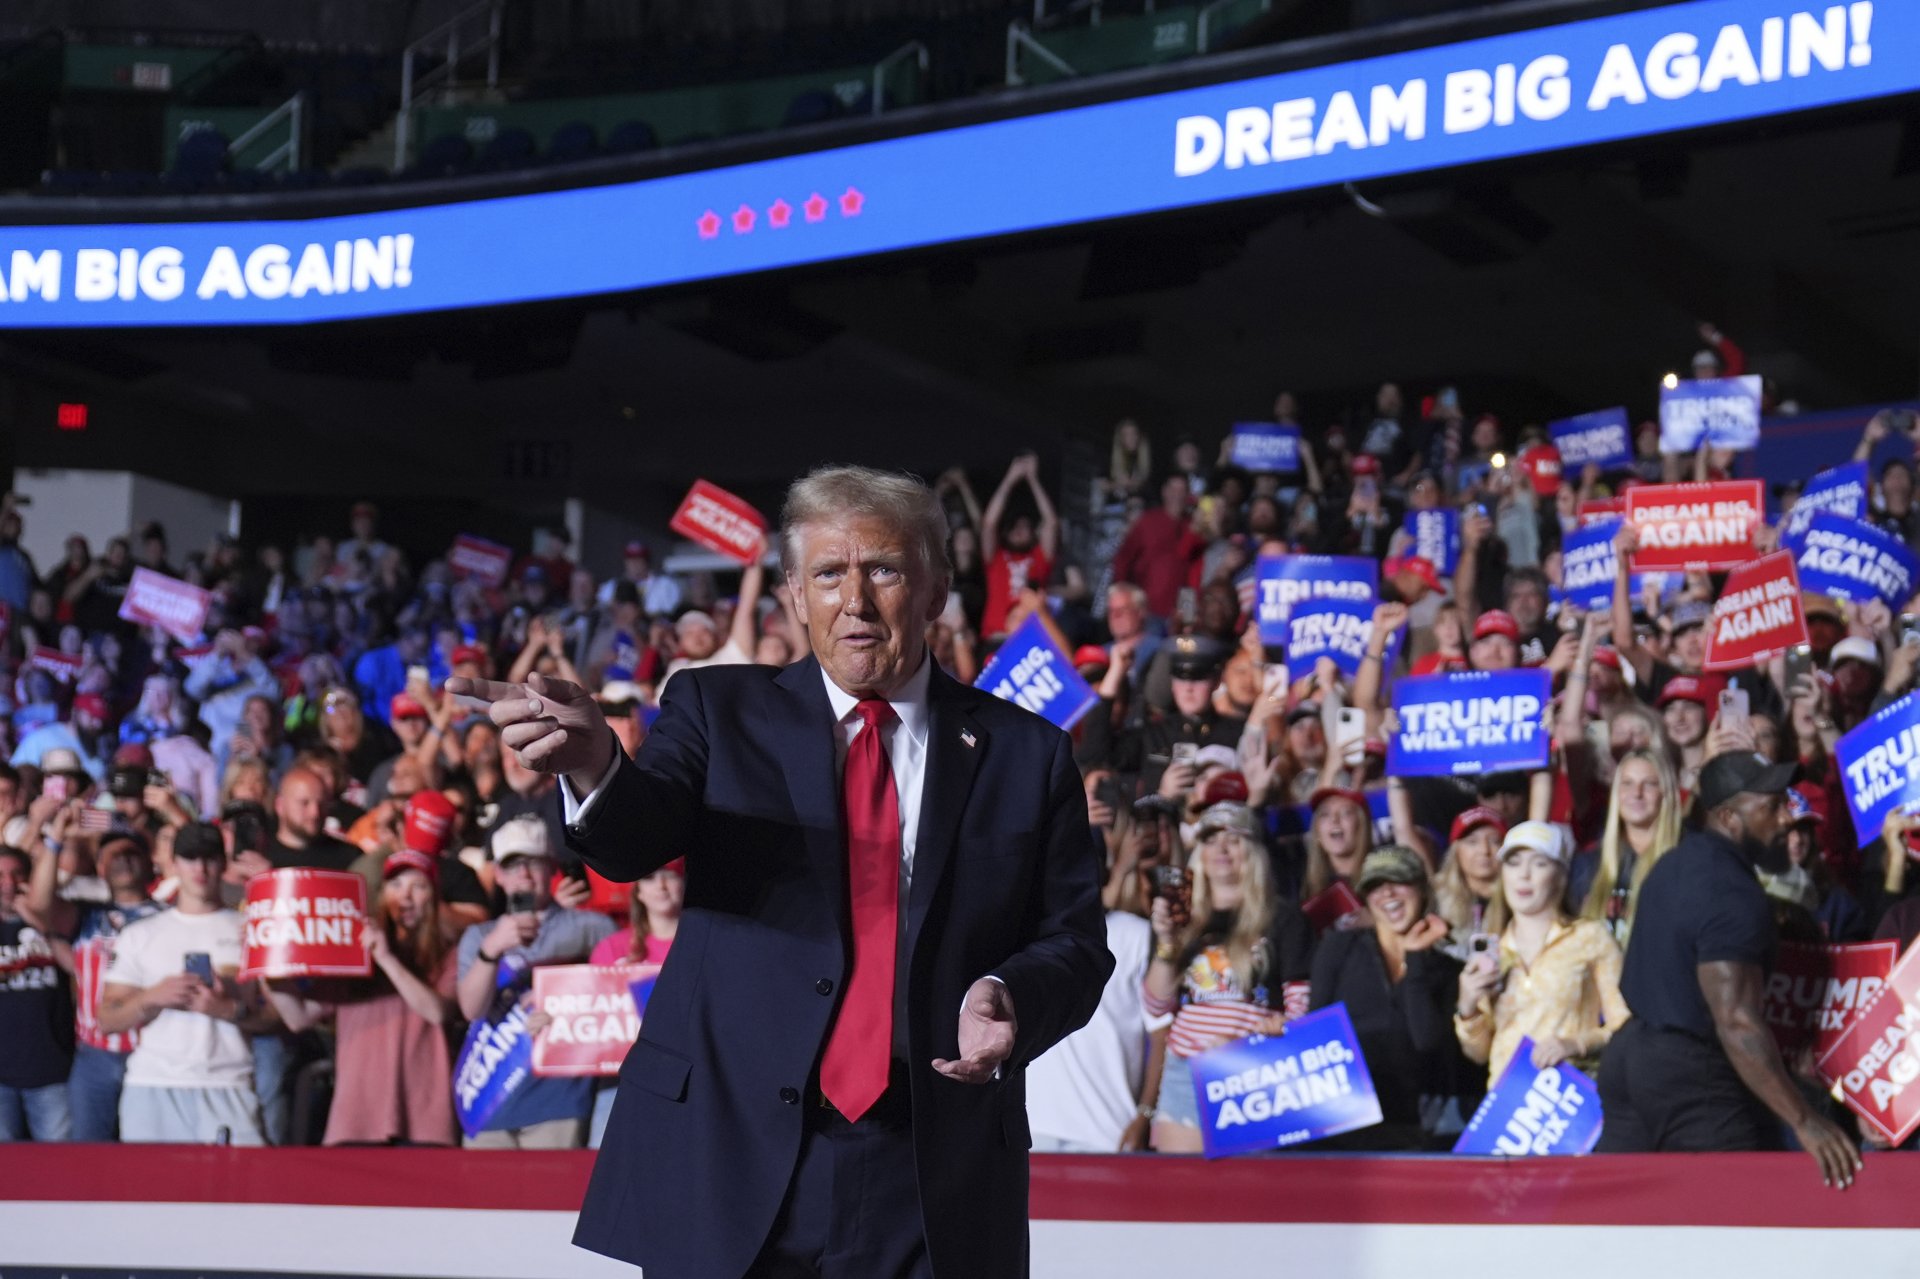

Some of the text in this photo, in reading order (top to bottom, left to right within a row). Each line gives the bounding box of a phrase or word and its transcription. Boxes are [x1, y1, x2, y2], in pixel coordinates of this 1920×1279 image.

[1174, 1, 1873, 177] DREAM BIG AGAIN!
[0, 233, 414, 301] M BIG AGAIN!
[1634, 502, 1710, 521] DREAM
[1713, 499, 1757, 520] BIG,
[1639, 518, 1748, 547] AGAIN!
[1805, 530, 1878, 561] DREAM
[1797, 545, 1899, 600] AGAIN!
[1717, 597, 1795, 646] AGAIN!
[1009, 645, 1054, 689] BIG,
[1399, 694, 1540, 733] TRUMP
[1400, 721, 1538, 752] WILL FIX IT
[1846, 723, 1920, 792] TRU
[1854, 768, 1906, 813] WILL
[315, 896, 361, 917] BIG,
[544, 993, 633, 1015] DREAM
[1764, 971, 1884, 1009] RUMP
[547, 1013, 638, 1044] AGAI
[1206, 1039, 1354, 1104] DREAM BIG,
[1215, 1063, 1352, 1130] AGAIN!
[1491, 1066, 1562, 1155] UMP
[1557, 1083, 1585, 1117] IT
